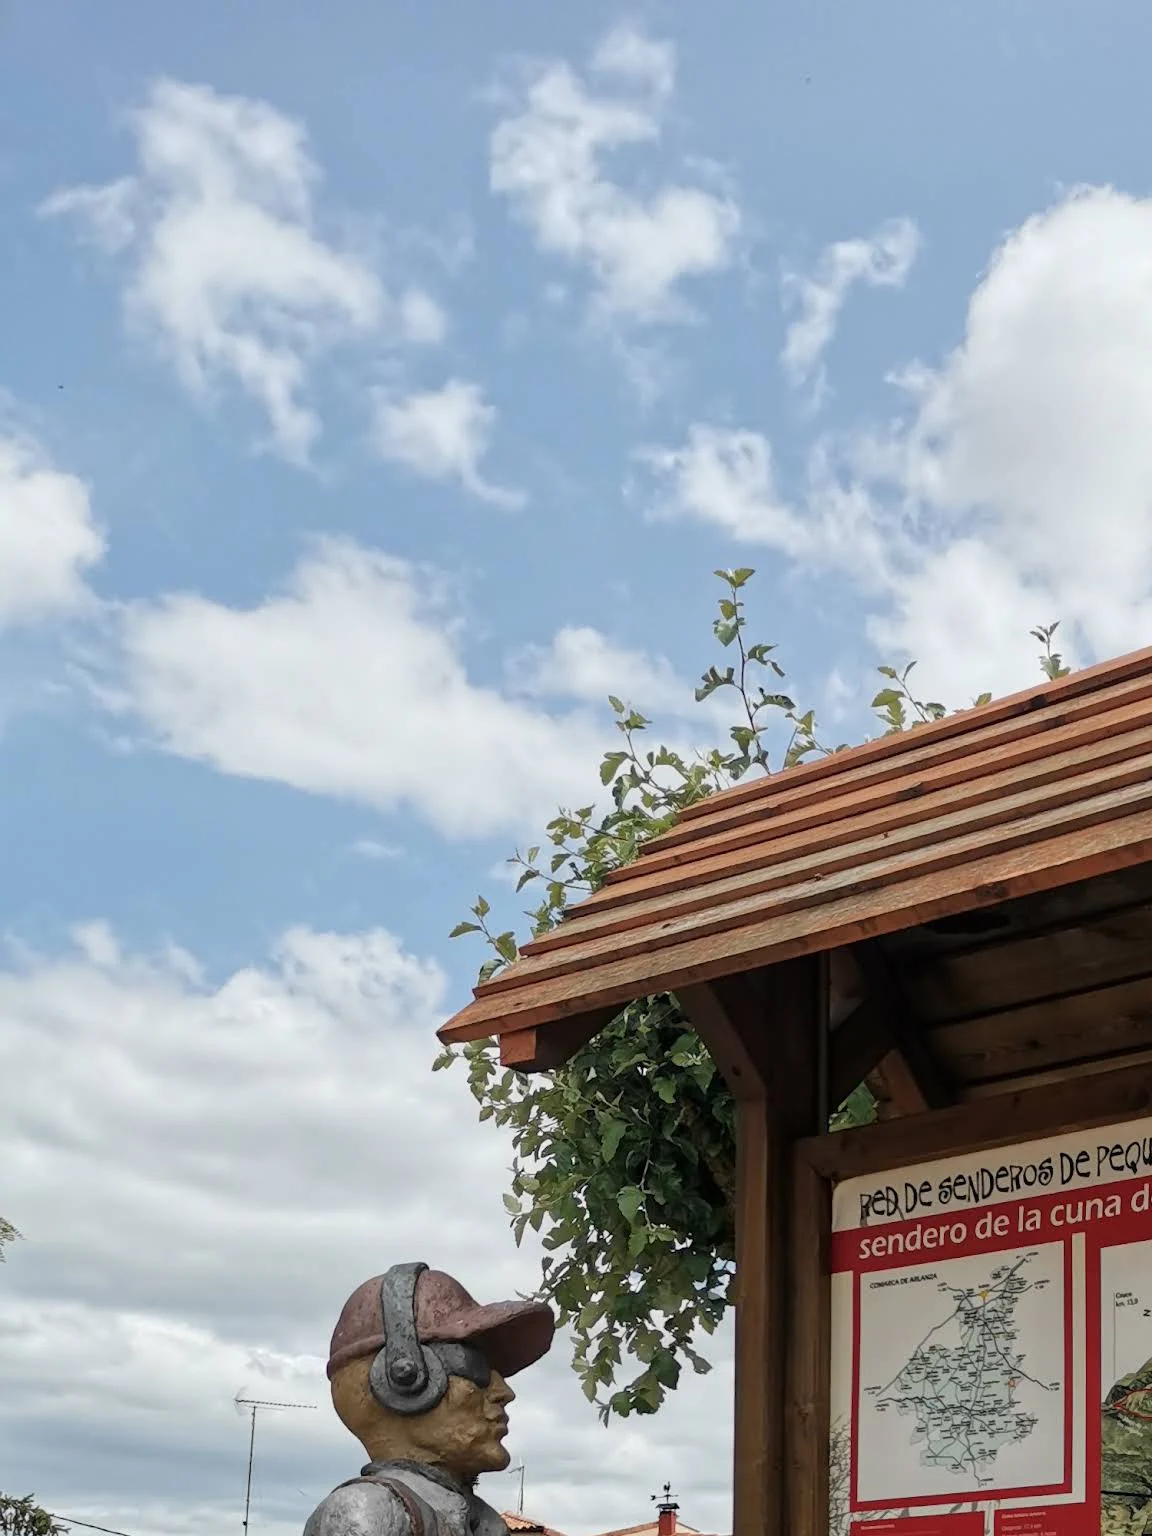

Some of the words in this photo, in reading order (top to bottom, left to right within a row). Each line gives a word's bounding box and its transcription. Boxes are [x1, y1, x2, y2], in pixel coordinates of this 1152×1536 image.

[859, 1222, 967, 1260] sendero
[975, 1211, 1010, 1239] de
[1018, 1205, 1042, 1233] la
[1050, 1193, 1121, 1225] cuna
